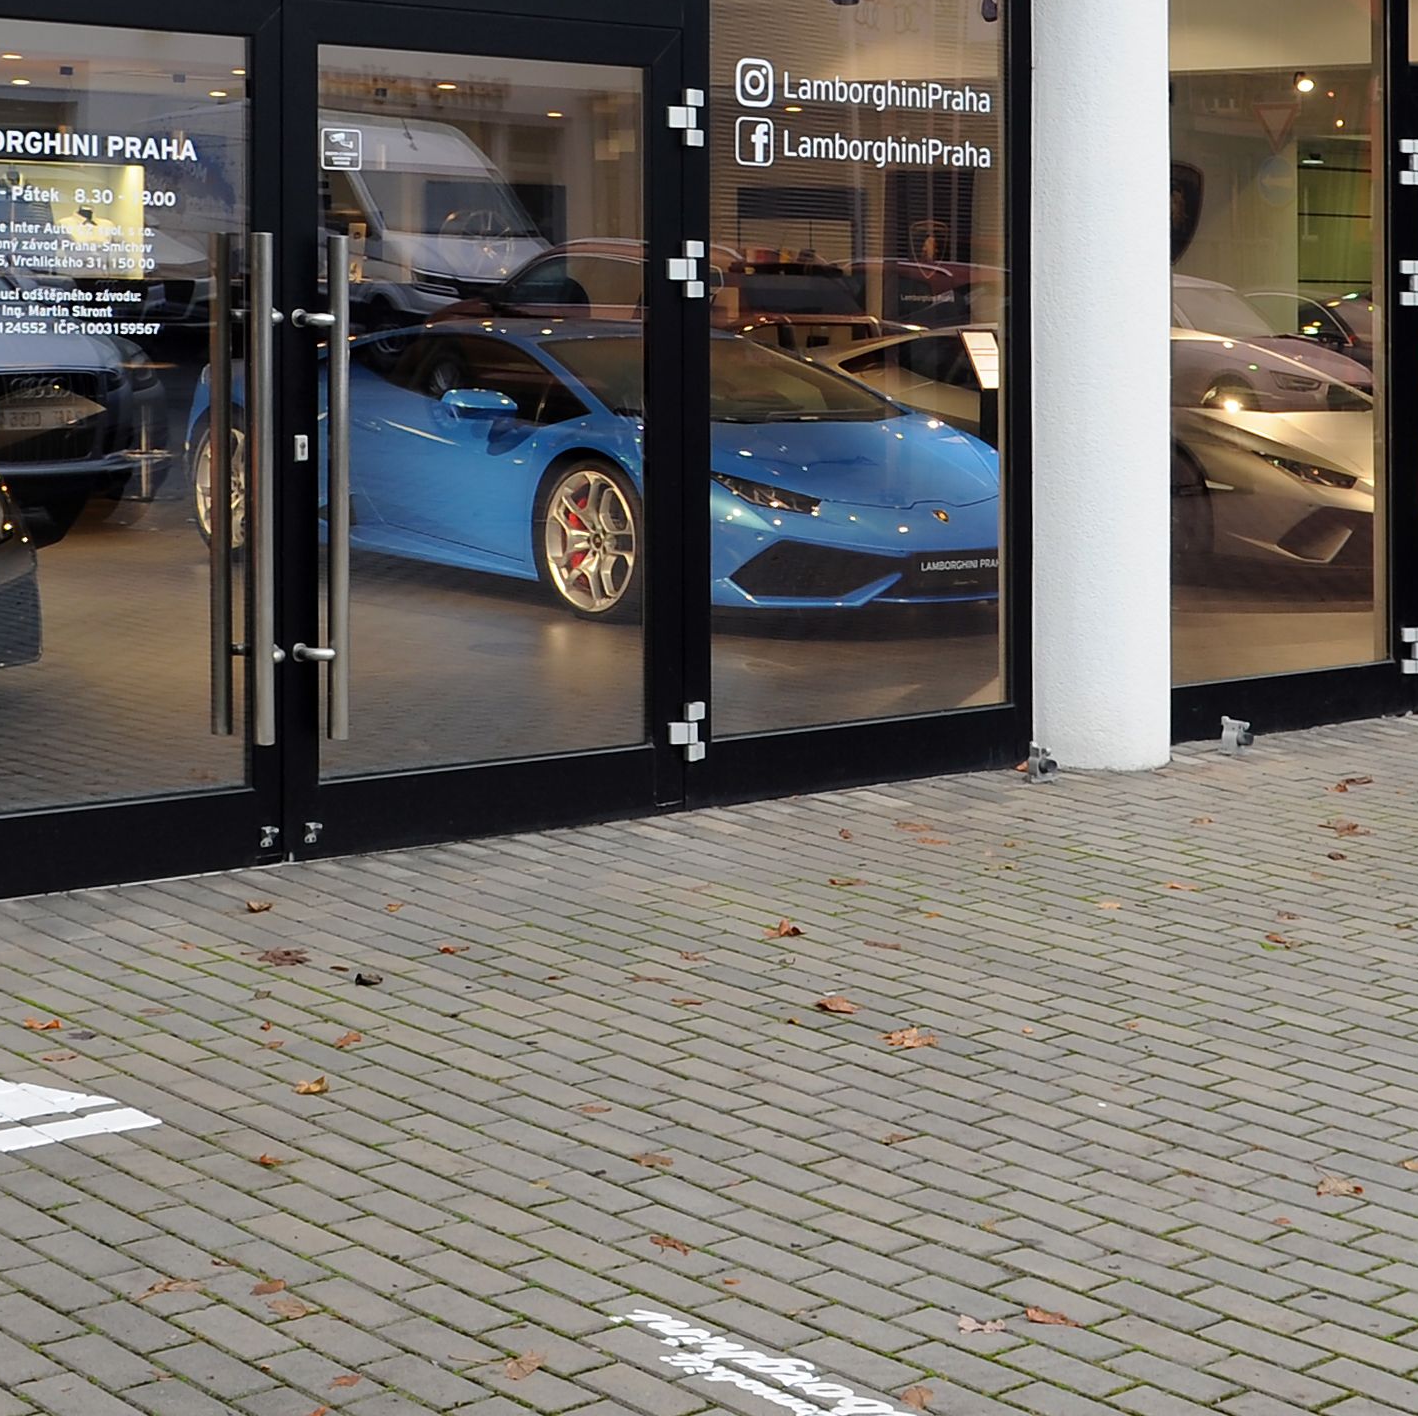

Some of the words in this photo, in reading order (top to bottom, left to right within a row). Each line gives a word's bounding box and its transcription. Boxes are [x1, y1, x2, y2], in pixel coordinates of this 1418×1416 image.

[783, 71, 991, 113] LamborghiniPraha
[107, 135, 198, 162] PRAHA
[783, 129, 991, 169] LamborghiniPraha
[11, 185, 60, 202] Pátek
[74, 188, 113, 205] 8.30
[9, 221, 41, 234] Inter
[21, 238, 58, 251] závod
[11, 254, 83, 268] Vrchlického
[21, 288, 93, 303] odštěpného
[2, 304, 25, 319] Ing.
[28, 305, 70, 317] Martin
[921, 559, 978, 572] LAMBORGHINI
[980, 558, 1000, 568] PRAH
